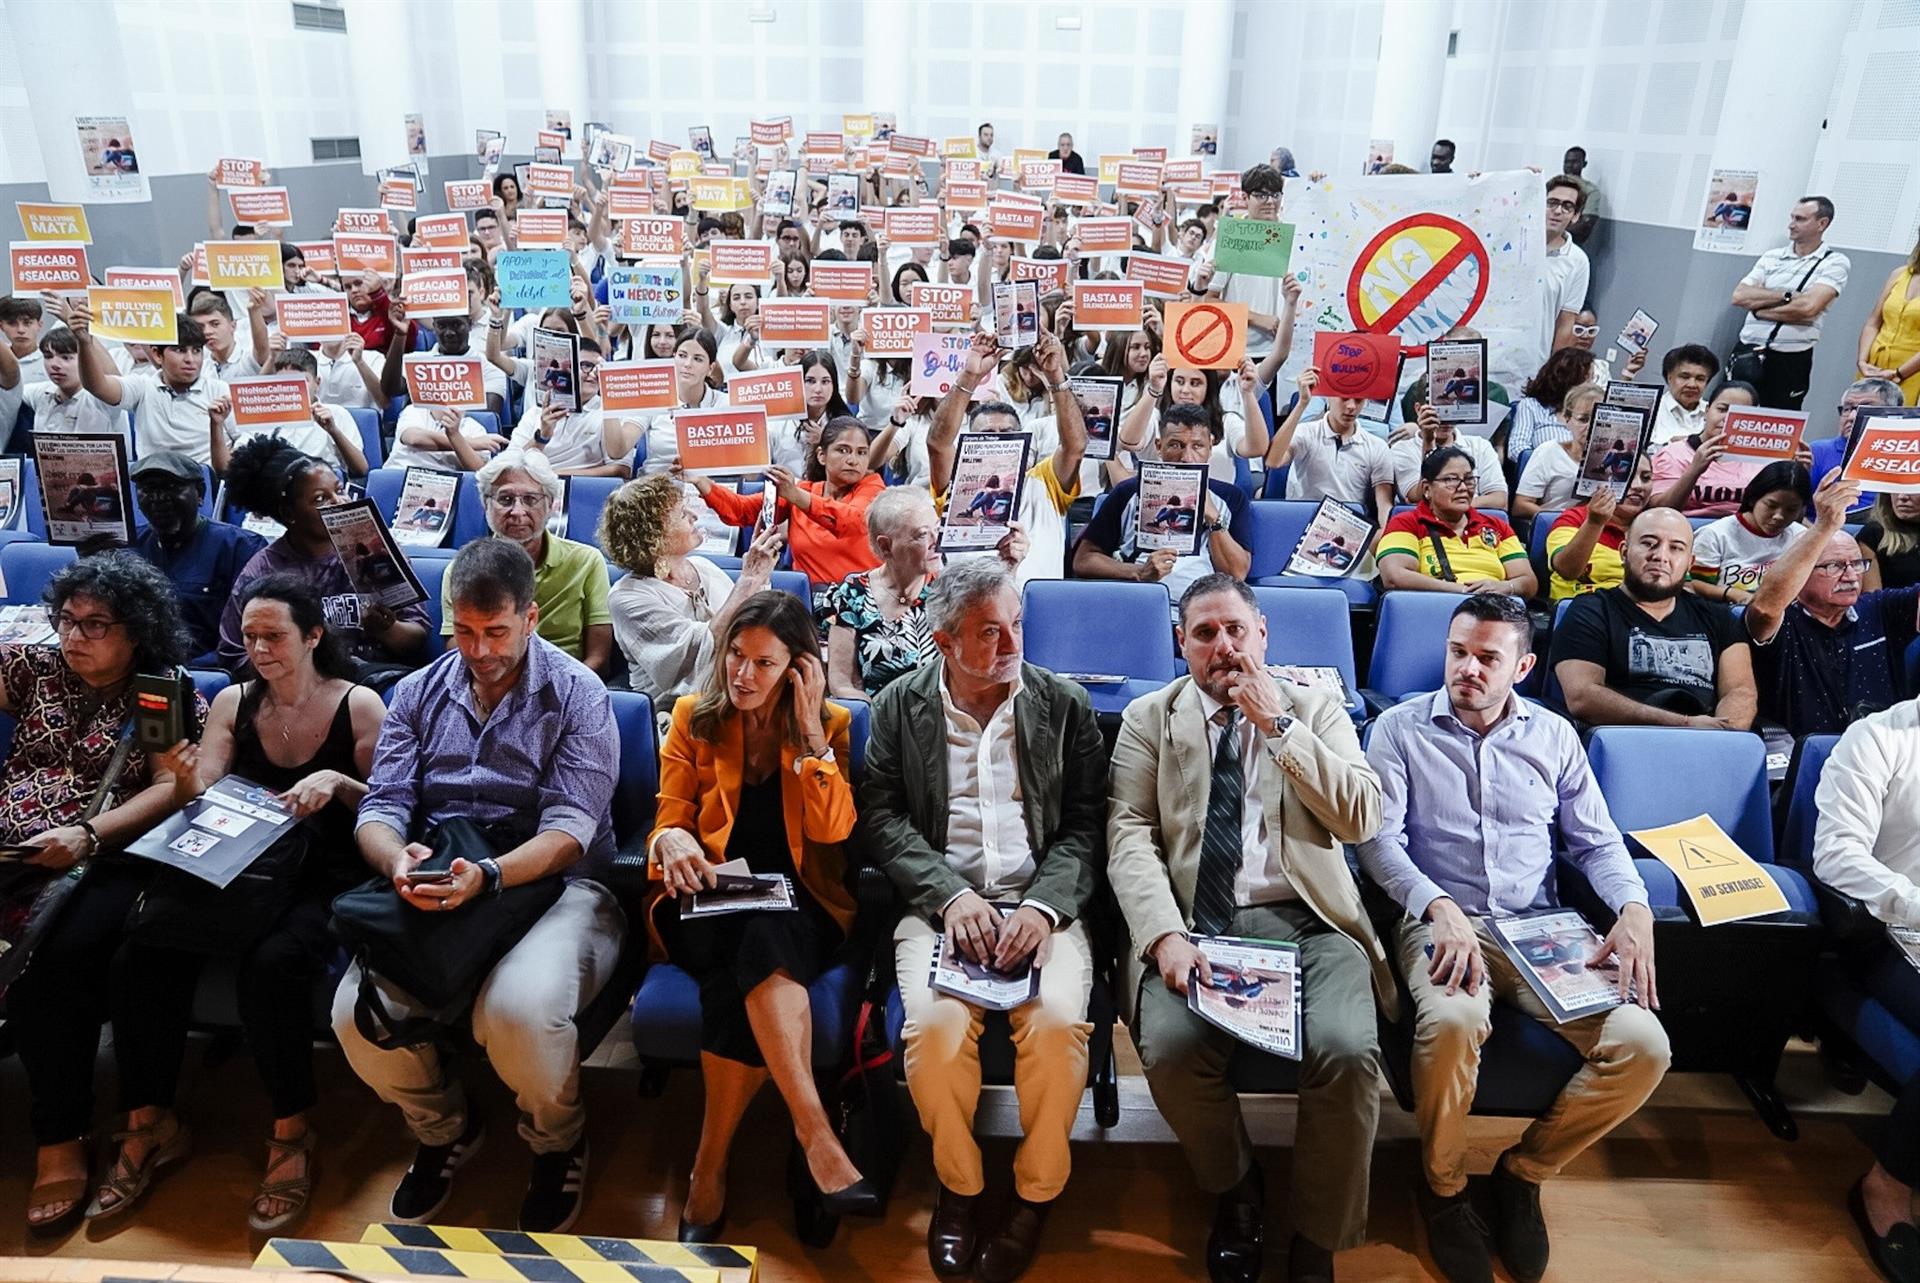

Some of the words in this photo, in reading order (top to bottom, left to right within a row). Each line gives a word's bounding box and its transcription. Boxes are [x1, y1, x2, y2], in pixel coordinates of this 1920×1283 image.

[222, 160, 254, 172] STOP
[950, 161, 976, 171] STOP
[1025, 164, 1055, 175] STOP
[451, 185, 485, 197] STOP
[343, 213, 379, 226] STOP
[995, 212, 1022, 223] BASTA
[1024, 215, 1035, 224] DE
[32, 221, 79, 234] MATA
[421, 224, 447, 234] BASTA
[449, 223, 459, 232] DE
[630, 220, 673, 235] STOP
[1224, 223, 1265, 236] STOP
[631, 235, 673, 243] VIOLENCIA
[342, 244, 372, 255] BASTA
[374, 245, 387, 254] DE
[631, 243, 675, 252] ESCOLAR
[18, 255, 77, 267] #SEACABO
[409, 258, 439, 268] BASTA
[441, 258, 453, 267] DE
[19, 270, 81, 282] #SEACABO
[218, 263, 273, 277] MATA
[1016, 264, 1059, 278] STOP
[408, 280, 460, 292] #SEACABO
[407, 292, 461, 304] #SEACABO
[919, 289, 963, 302] STOP
[1083, 292, 1116, 303] BASTA
[1118, 293, 1133, 303] DE
[102, 302, 113, 311] EL
[115, 302, 162, 312] BULLYING
[103, 311, 165, 328] MATA
[931, 311, 963, 320] COLAR
[871, 314, 921, 331] STOP
[872, 338, 914, 349] ESCOLA
[941, 336, 971, 350] STOP
[1337, 344, 1363, 358] STOP
[414, 363, 470, 381] STOP
[416, 381, 471, 392] VIOLENCIA
[738, 383, 773, 397] BASTA
[776, 381, 793, 392] DE
[419, 390, 474, 402] ESCOLAR
[738, 391, 794, 403] SILENCIAMIENTO
[687, 424, 732, 439] BASTA
[736, 423, 754, 436] DE
[1732, 418, 1796, 435] #SEACABO
[688, 435, 756, 448] SILENCIAMIENTO
[1727, 434, 1792, 451] #SEACABO
[1716, 877, 1764, 895] SENTARSE!
